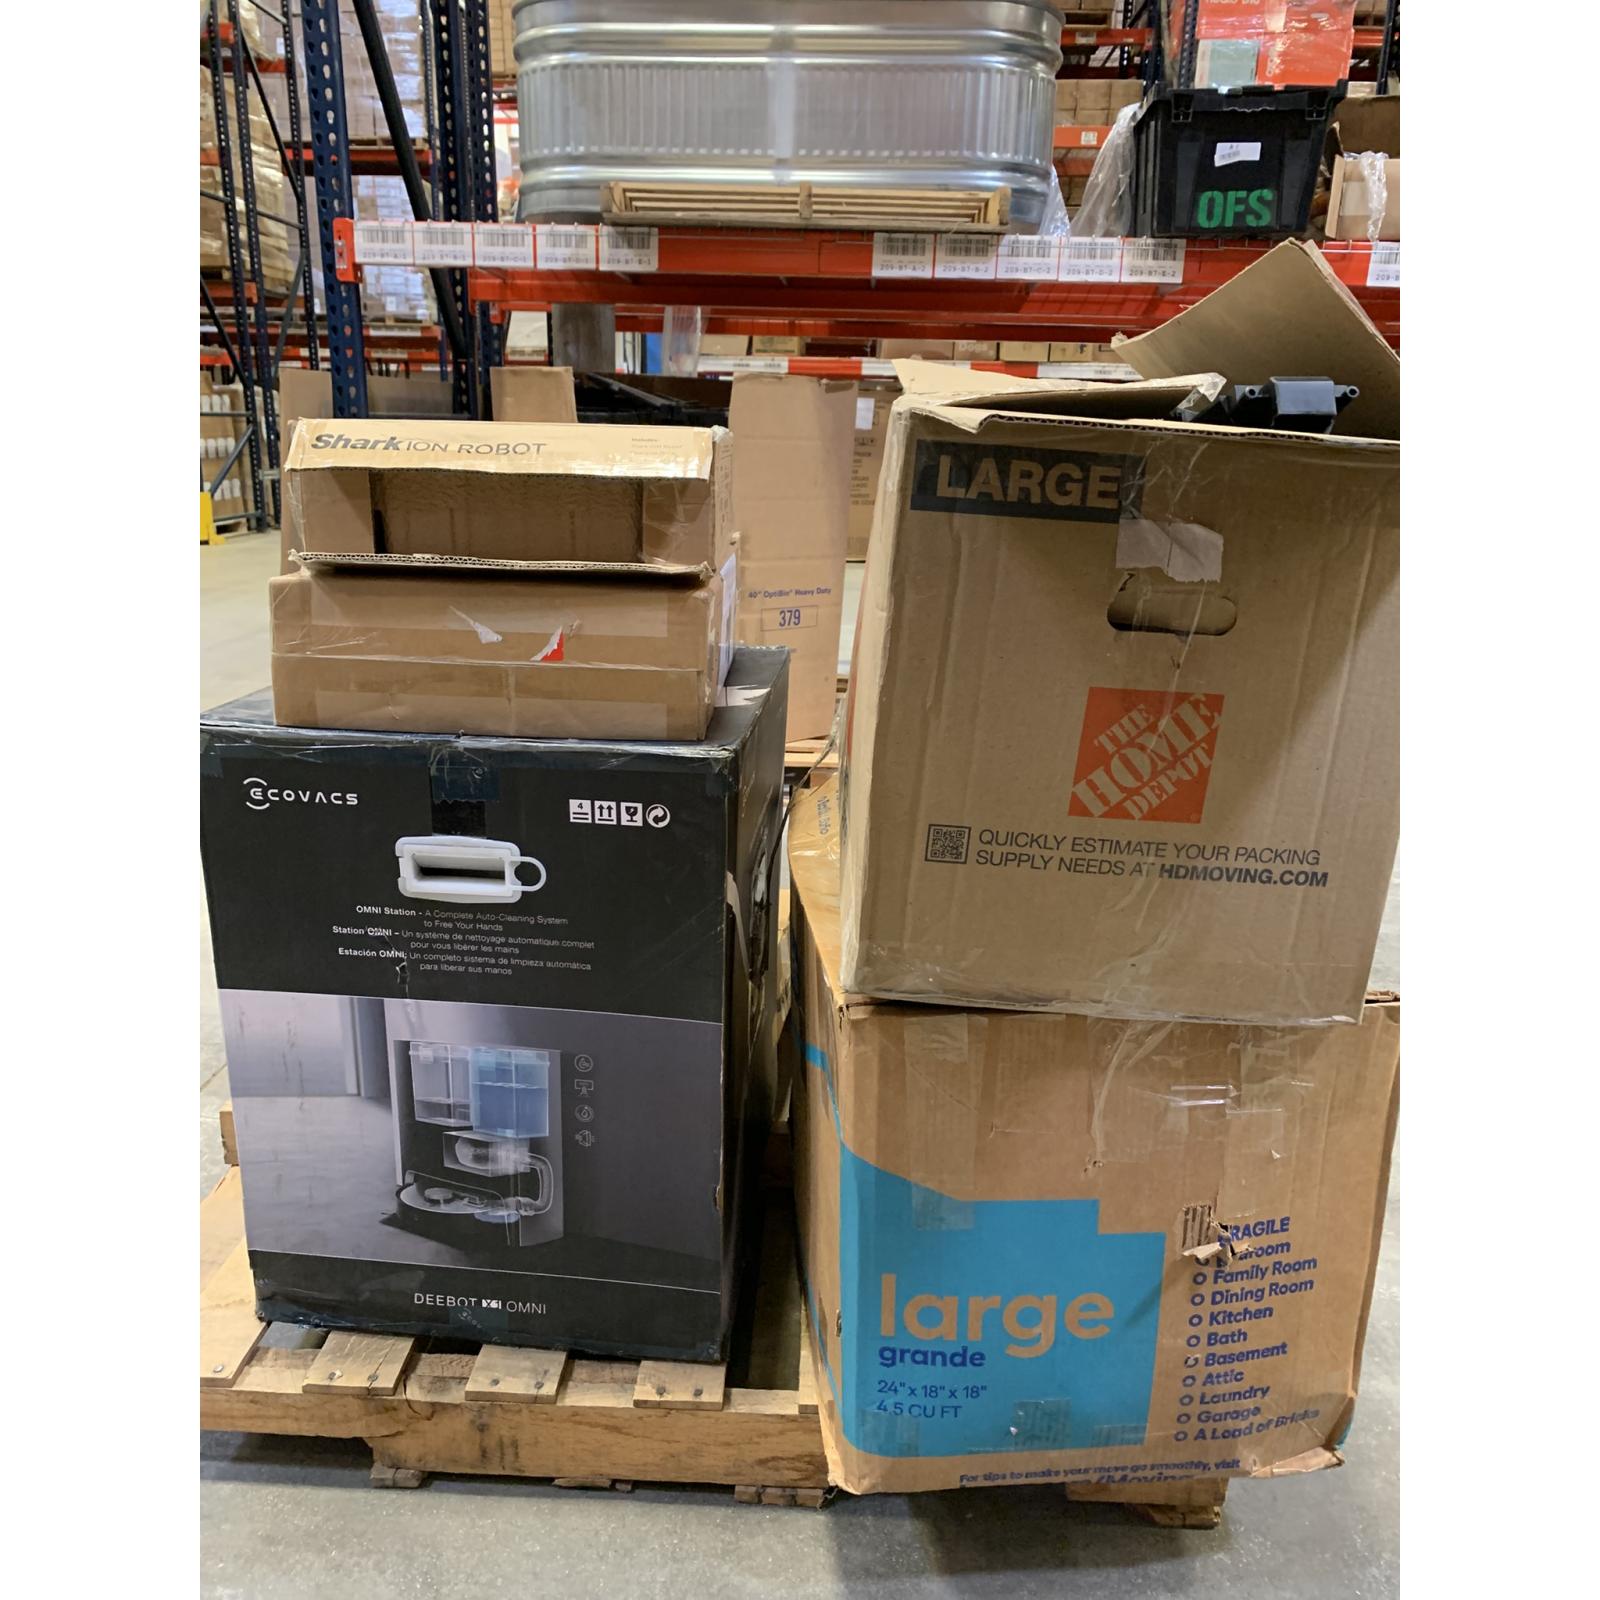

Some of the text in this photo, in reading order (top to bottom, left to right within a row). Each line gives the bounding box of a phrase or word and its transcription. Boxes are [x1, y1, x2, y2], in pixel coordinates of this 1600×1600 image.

[1197, 188, 1273, 228] OFS
[311, 433, 547, 456] Shark ION ROBOT
[936, 454, 1122, 510] LARGE
[794, 588, 815, 597] Heavy
[816, 587, 832, 595] Duty
[778, 608, 801, 628] 379
[1094, 703, 1156, 754] THE
[1072, 693, 1221, 818] HOME
[1122, 742, 1213, 820] DEPOT
[247, 784, 358, 806] ECOVACS
[978, 828, 1321, 866] QUICKLY ESTIMATE YOUR PACKING
[975, 849, 1329, 887] SUPPLY NEEDS AT HDMOVING.COM
[356, 905, 382, 914] OMNI
[384, 906, 417, 917] Station
[433, 909, 473, 920] Complete
[476, 912, 536, 925] Auto-Cleaning
[537, 915, 569, 926] System
[424, 920, 504, 932] to Free Your Hands
[332, 925, 365, 935] Station
[401, 930, 414, 938] Un
[452, 932, 463, 940] de
[465, 933, 506, 945] nettoyage
[508, 936, 560, 947] automatique
[561, 939, 595, 950] complet
[410, 941, 429, 950] pour
[431, 942, 451, 950] vous
[481, 944, 493, 953] les
[494, 946, 520, 954] mains
[338, 947, 377, 957] Estación
[409, 952, 421, 960] Un
[423, 953, 460, 964] completo
[463, 955, 496, 965] sistema
[498, 957, 509, 965] de
[510, 957, 544, 968] limpieza
[420, 962, 513, 976] para liberar sus manos
[1213, 1257, 1318, 1285] Family Room
[414, 1292, 478, 1307] DEEBOT
[506, 1300, 547, 1315] OMNI
[1210, 1278, 1315, 1306] Dining Room
[879, 1273, 1116, 1359] large
[1209, 1306, 1274, 1327] Kitchen
[1206, 1328, 1248, 1347] Bath
[878, 1345, 987, 1368] grande
[1204, 1341, 1288, 1367] Basement
[877, 1378, 988, 1399] 24" x 18" x 18"
[1202, 1369, 1245, 1387] Attic
[1199, 1385, 1271, 1405] Laundry
[876, 1399, 963, 1419] 4.5 CU FT
[1197, 1405, 1262, 1424] Garage
[1193, 1408, 1321, 1441] A Load of Bricks
[959, 1474, 979, 1484] For
[982, 1472, 1007, 1482] tips
[1009, 1471, 1023, 1480] to
[1024, 1468, 1062, 1479] make
[1063, 1467, 1092, 1477] your
[1093, 1464, 1129, 1474] move
[1130, 1463, 1148, 1473] go
[1150, 1460, 1211, 1472] smoothly,
[1214, 1459, 1241, 1470] visit
